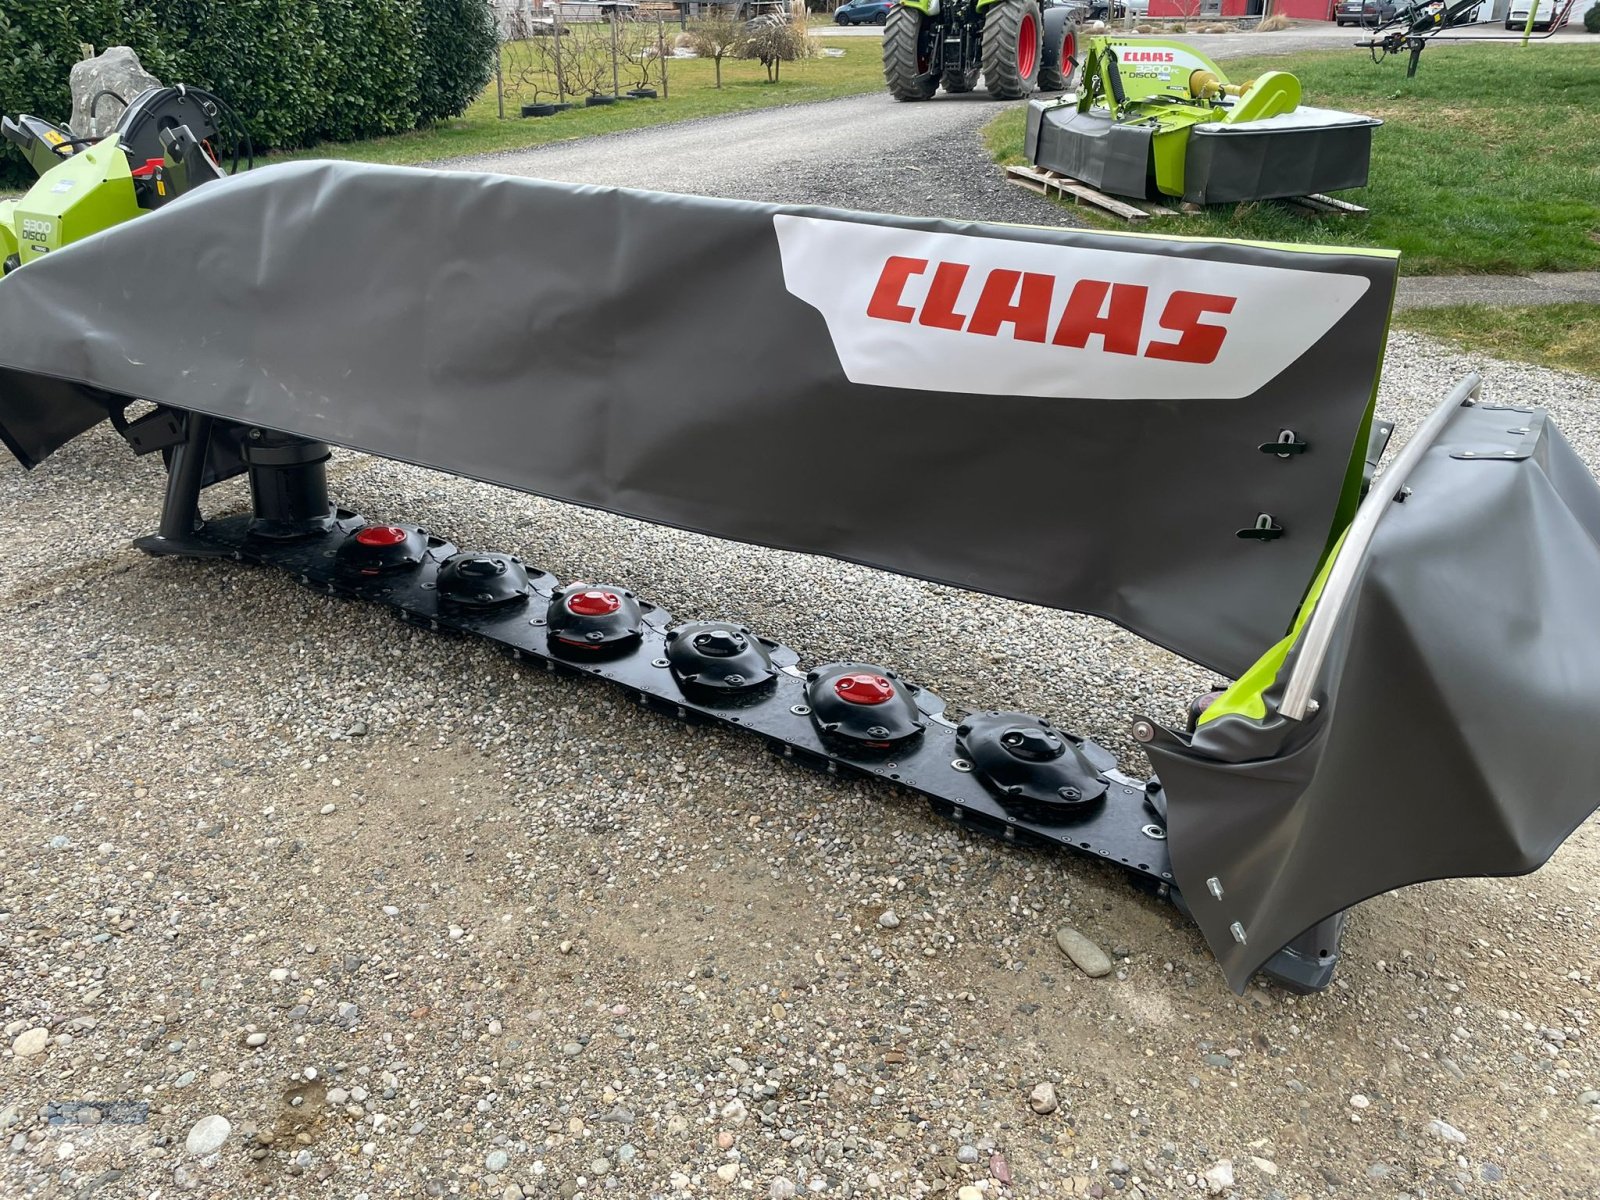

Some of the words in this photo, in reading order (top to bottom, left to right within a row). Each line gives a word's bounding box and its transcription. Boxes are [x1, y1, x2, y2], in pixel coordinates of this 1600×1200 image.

[1123, 52, 1174, 62] CLAAS
[1135, 64, 1171, 73] 3200
[23, 219, 51, 233] 9300
[22, 230, 47, 242] DISCO
[866, 255, 1237, 364] CLAAS
